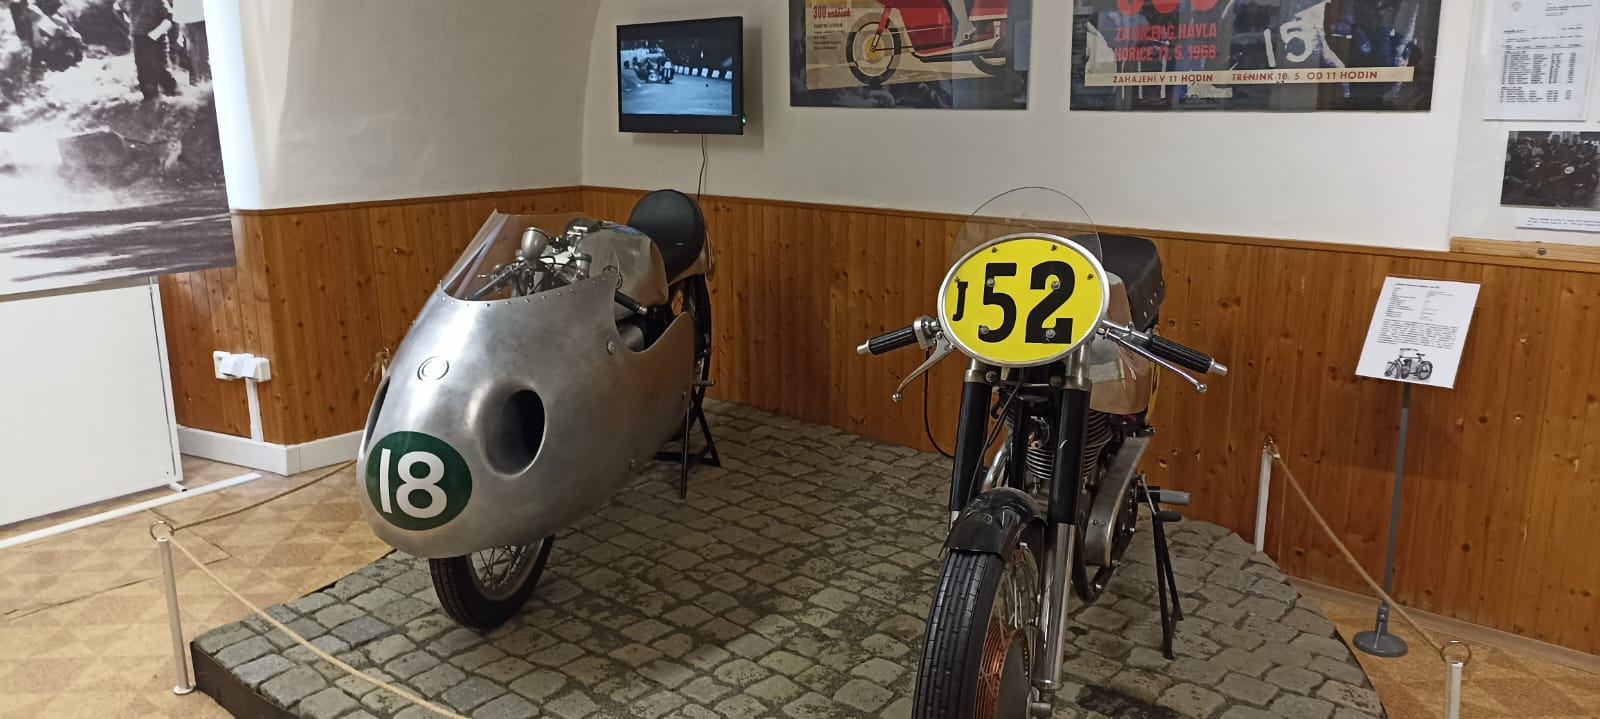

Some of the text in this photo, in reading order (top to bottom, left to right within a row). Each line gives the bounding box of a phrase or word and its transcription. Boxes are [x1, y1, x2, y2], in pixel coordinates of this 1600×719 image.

[813, 5, 827, 19] 300
[1178, 22, 1217, 39] HAVLA
[1189, 44, 1217, 60] 1968
[1263, 22, 1315, 68] 15
[1159, 75, 1166, 83] V
[1181, 73, 1213, 83] HODIN
[1307, 71, 1324, 80] OD
[1327, 71, 1336, 80] 11
[1340, 71, 1378, 80] HODIN
[978, 260, 1075, 344] 52
[379, 448, 448, 519] 18
